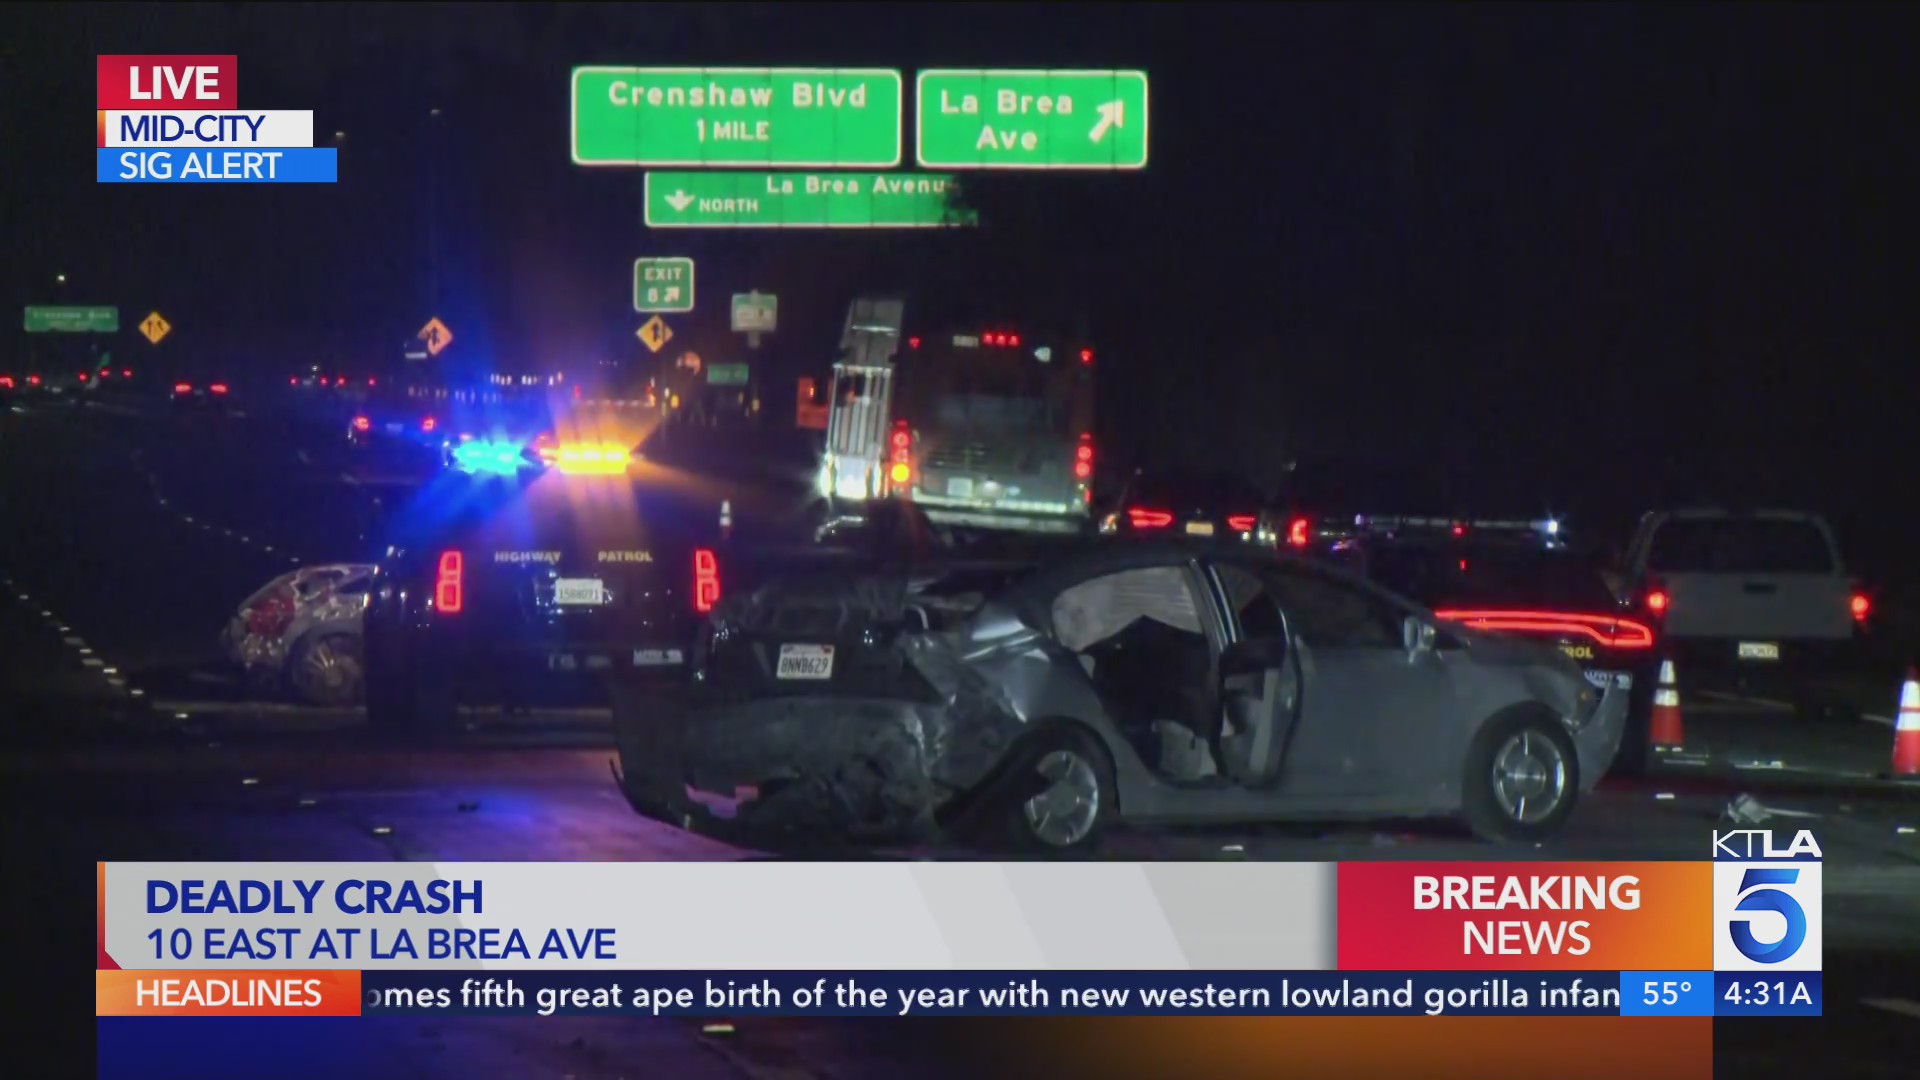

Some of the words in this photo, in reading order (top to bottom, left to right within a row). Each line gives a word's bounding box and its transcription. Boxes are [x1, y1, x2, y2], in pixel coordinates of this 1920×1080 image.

[608, 82, 772, 107] Crenshaw
[792, 82, 866, 108] Blvd
[941, 89, 979, 114] La
[997, 89, 1073, 115] Brea
[697, 120, 705, 141] 1
[713, 121, 769, 141] MILE
[976, 125, 1038, 151] Ave
[766, 175, 794, 194] La
[805, 175, 860, 194] Brea
[872, 175, 954, 194] Avenu
[699, 198, 759, 213] NORTH
[645, 267, 682, 281] EXIT
[494, 551, 561, 562] HIGHWAY
[597, 551, 653, 562] PATROL
